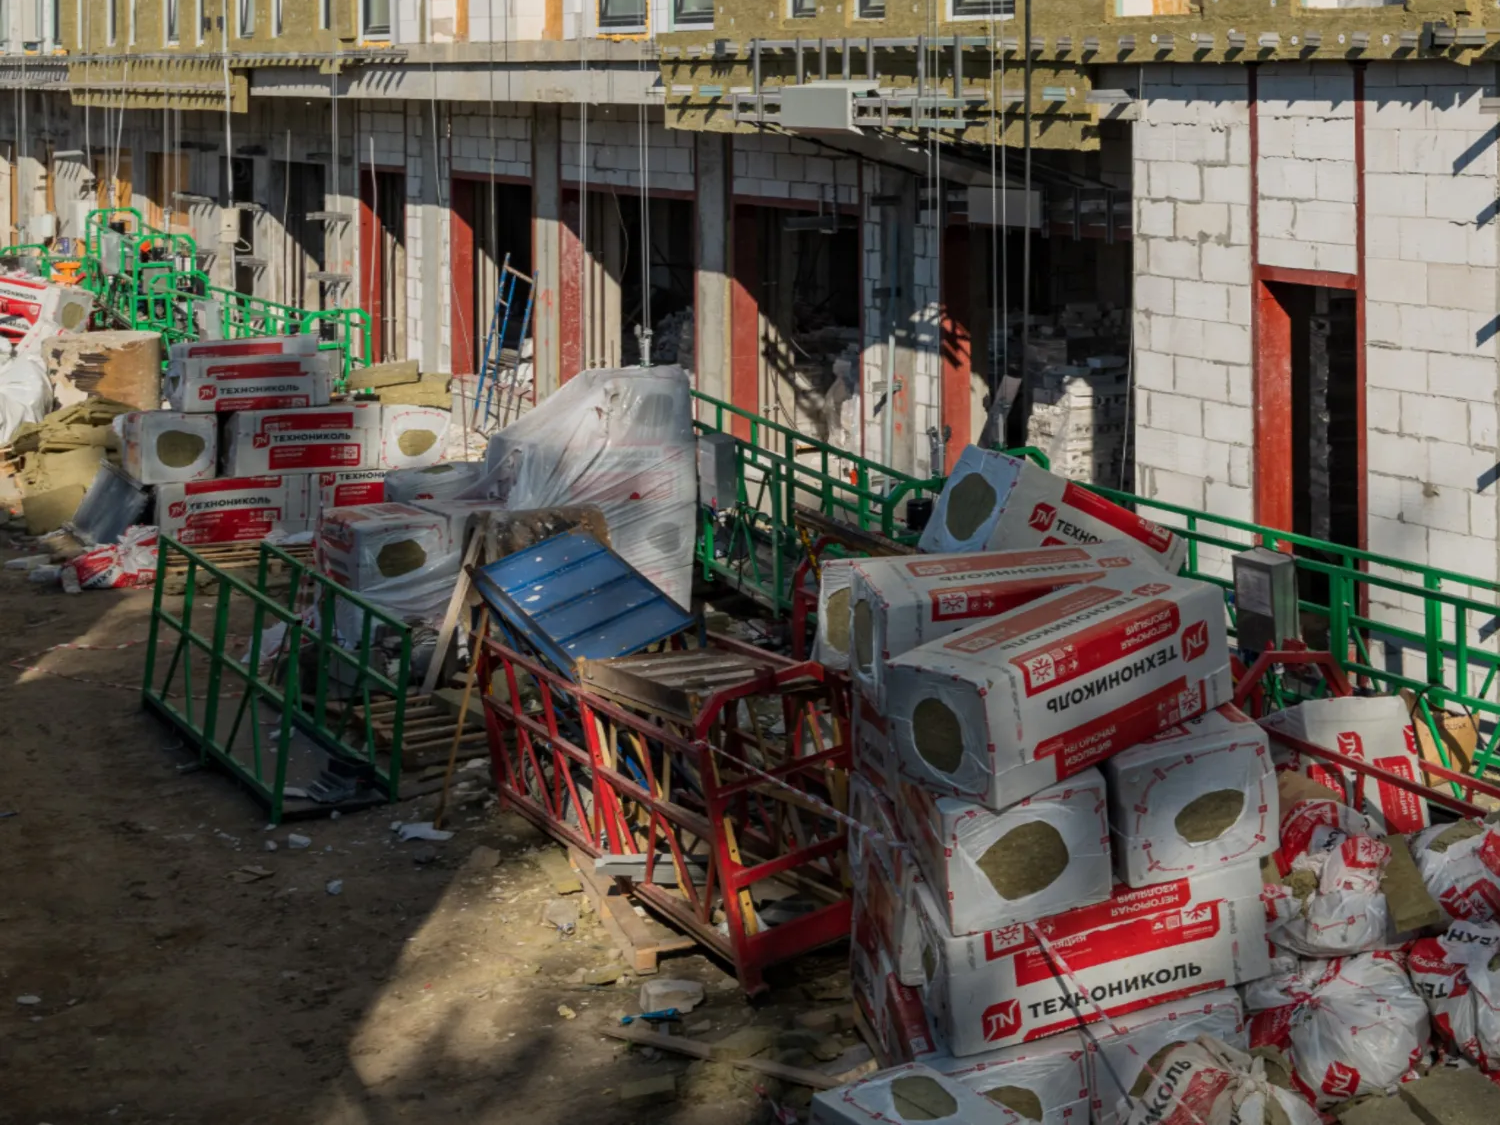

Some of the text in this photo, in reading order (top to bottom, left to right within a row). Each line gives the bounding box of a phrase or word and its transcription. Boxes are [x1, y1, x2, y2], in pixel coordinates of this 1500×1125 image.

[219, 384, 300, 395] ТЕХНОНИКОЛЬ
[272, 432, 352, 443] ТЕХНОНИКОЛЬ
[189, 496, 272, 510] ТЕХНОНИКОЛЬ
[939, 561, 1095, 582] ТЕХНОНИКОЛЬ
[1000, 595, 1138, 651] ТЕХНОНИКОЛЬ
[1120, 623, 1172, 650] НЕГОРЮЧАЯ
[1046, 644, 1178, 714] ТЕХНОНИКОЛЬ
[1110, 893, 1179, 918] НЕГОРЮЧАЯ
[1117, 883, 1179, 905] ИЗОЛЯЦИЯ
[1027, 962, 1202, 1019] ТЕХНОНИКОЛЬ
